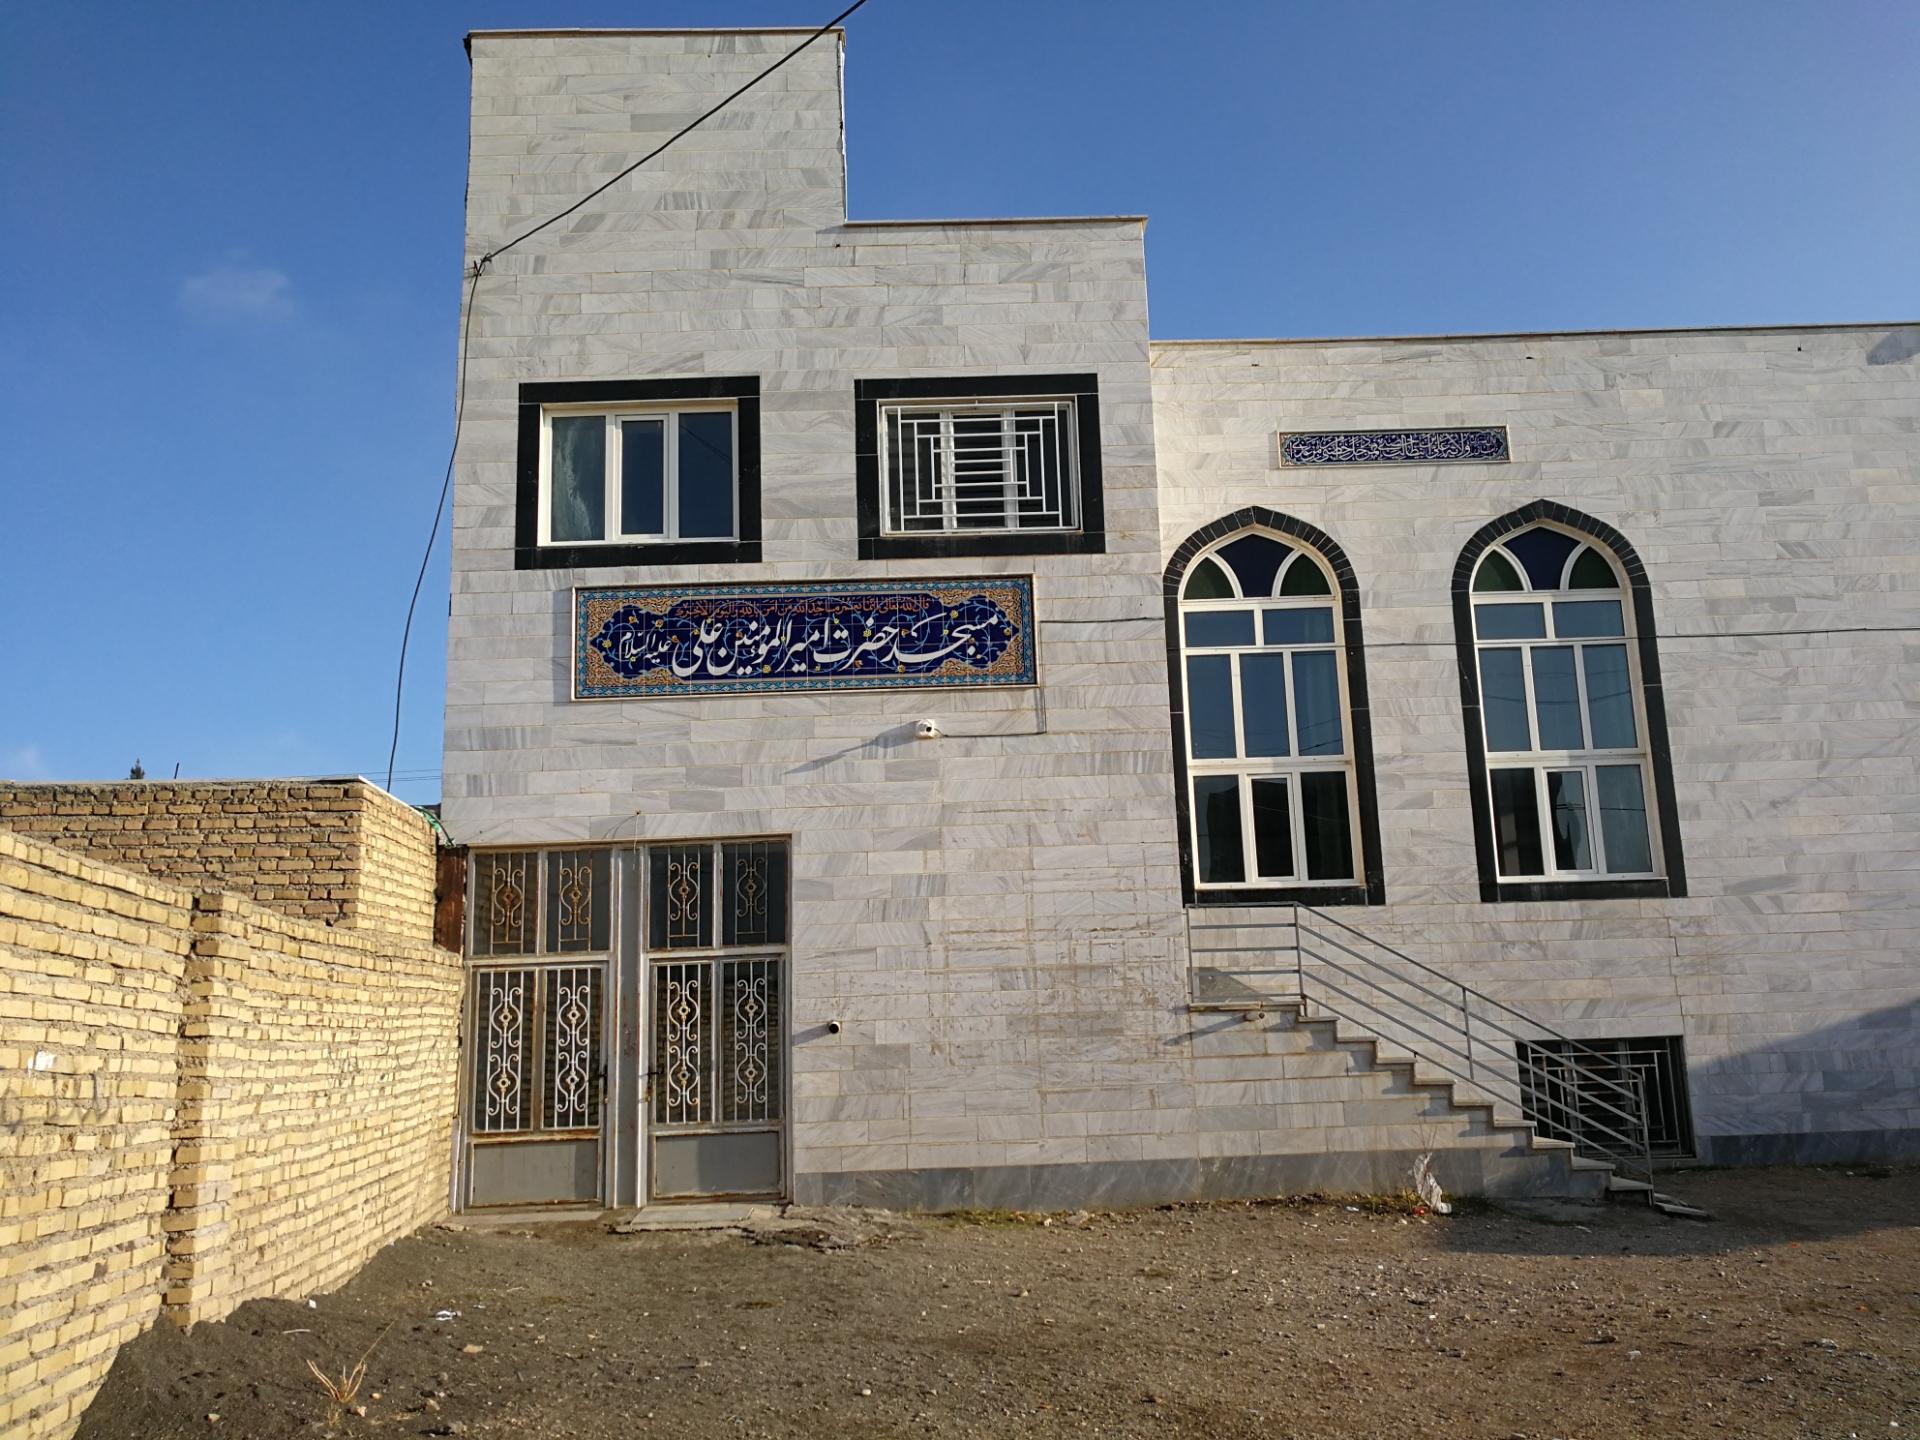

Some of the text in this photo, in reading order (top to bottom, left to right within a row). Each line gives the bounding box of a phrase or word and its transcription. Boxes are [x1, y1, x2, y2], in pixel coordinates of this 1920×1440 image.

[644, 639, 672, 664] علیه
[672, 618, 723, 677] علی
[775, 617, 830, 674] امیر
[813, 617, 899, 672] حضرت
[880, 613, 998, 663] مسجد
